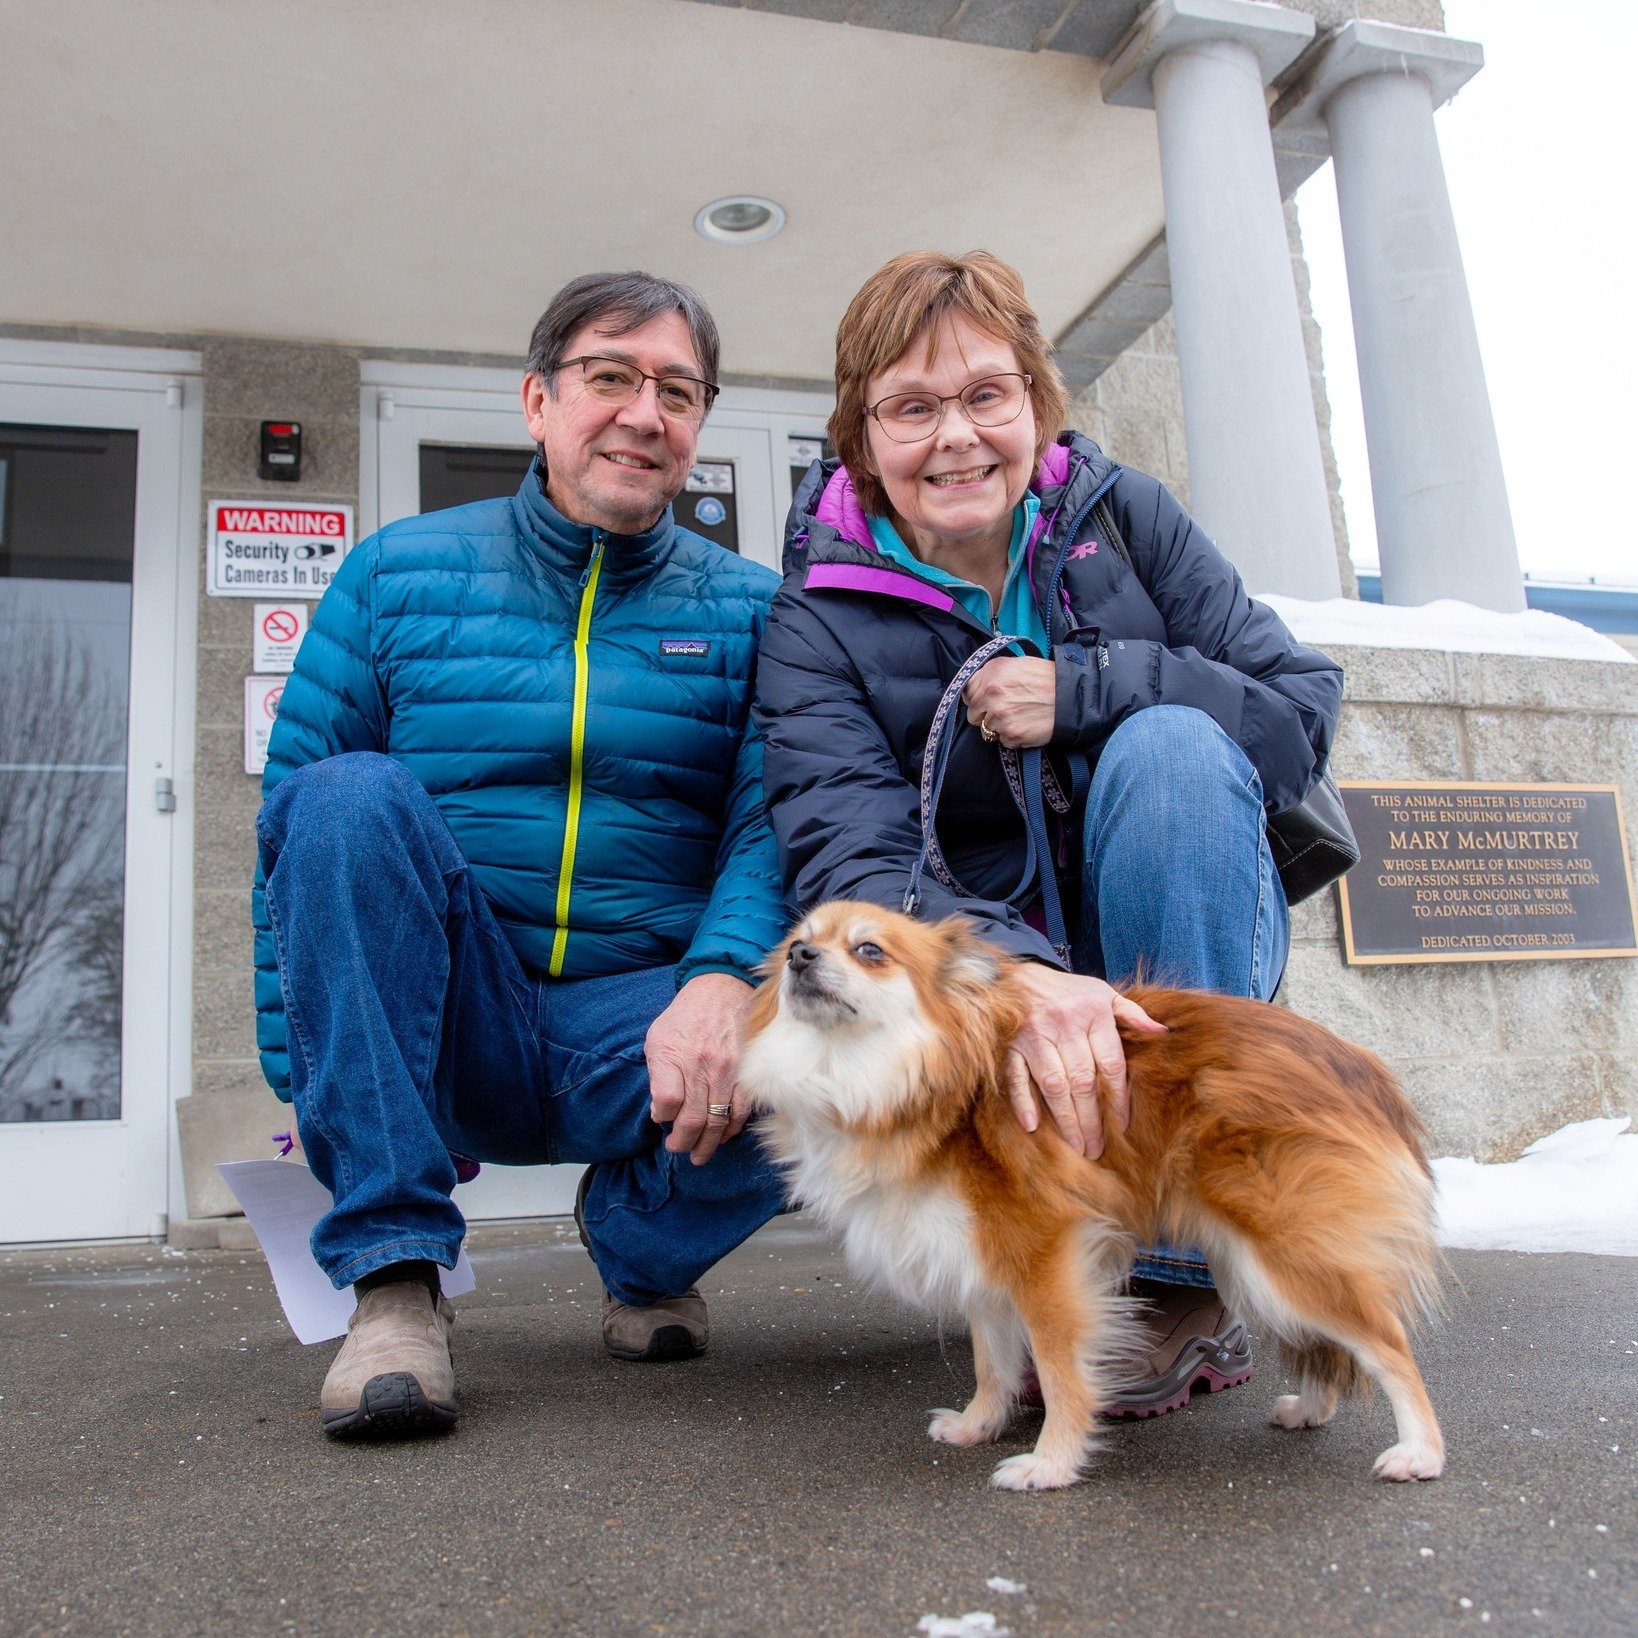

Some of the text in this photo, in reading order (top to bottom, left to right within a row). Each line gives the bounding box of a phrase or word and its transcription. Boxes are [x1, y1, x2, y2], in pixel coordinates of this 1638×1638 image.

[223, 510, 341, 535] WARNING
[225, 540, 290, 563] Security
[225, 564, 288, 584] Cameras
[293, 566, 307, 584] In
[665, 645, 704, 654] patagonia
[1371, 795, 1587, 809] THIS ANIMAL SHELTER IS DEDICATED
[1391, 810, 1573, 823] TO THE ENDURING MEMORY OF
[1389, 831, 1579, 850] MARY McMURTREY
[1382, 858, 1592, 871] WHOSE EXAMPLE OF KINDNESS AND
[1378, 873, 1599, 887] COMPASSION SERVES AS INSPIRATION
[1416, 888, 1569, 902] FOR OUR ONGOING WORK
[1412, 903, 1576, 917] TO ADVANCE OUR MISSION.
[1421, 933, 1575, 949] DEDICATED OCTOBER 2003
